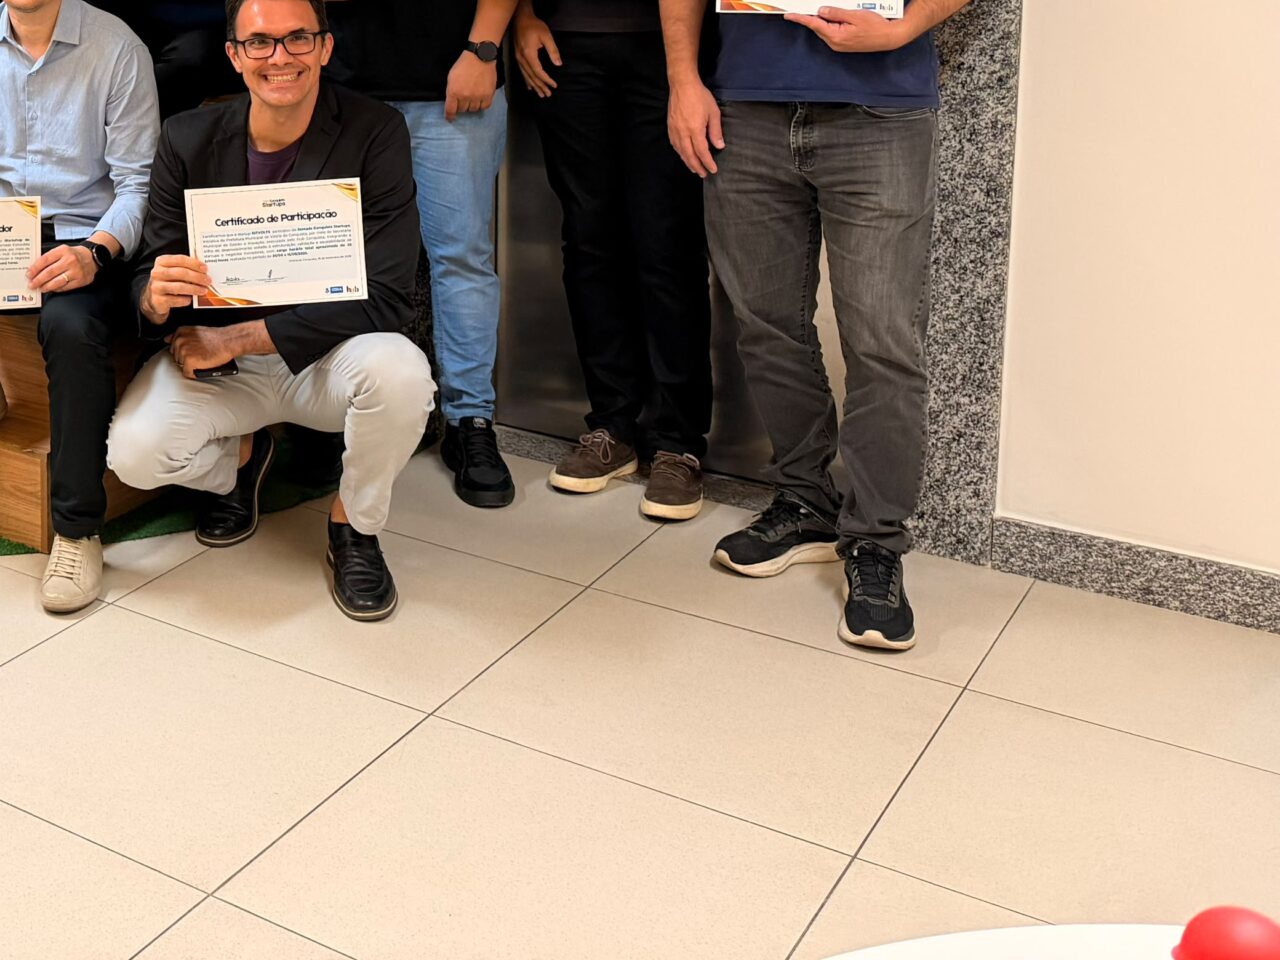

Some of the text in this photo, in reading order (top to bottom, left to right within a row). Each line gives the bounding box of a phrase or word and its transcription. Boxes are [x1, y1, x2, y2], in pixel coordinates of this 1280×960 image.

[214, 208, 338, 227] Certificado de Participação
